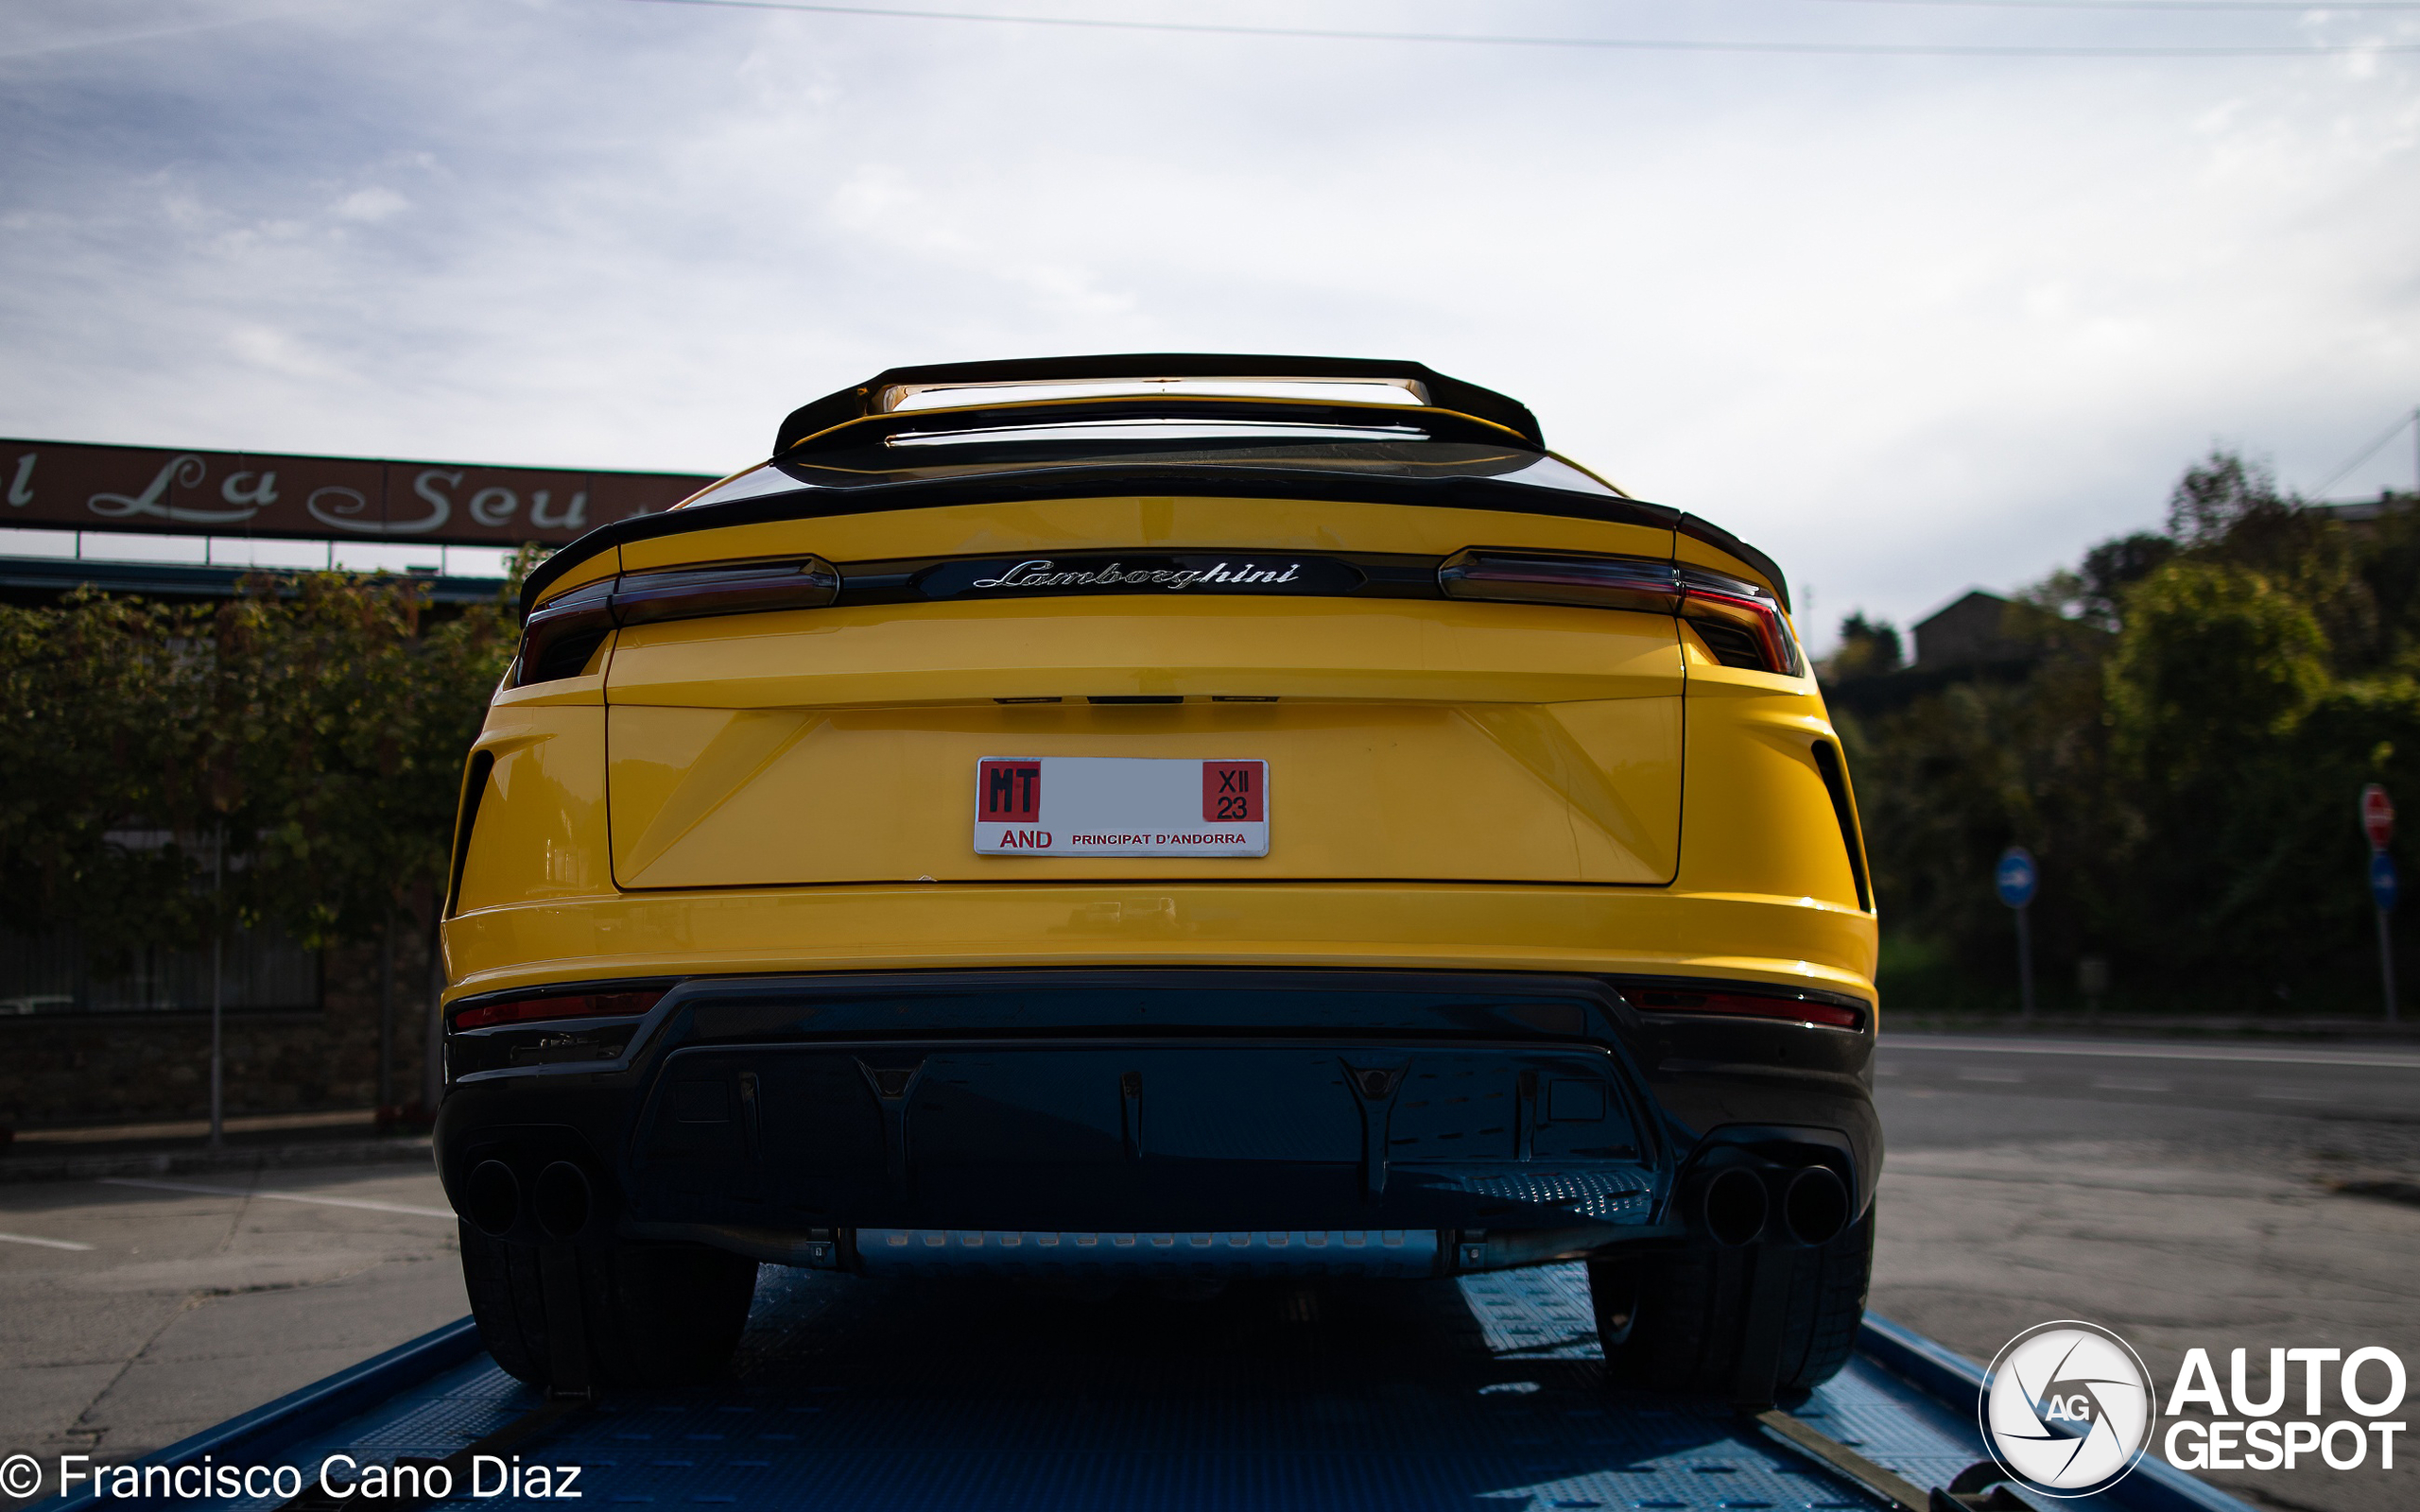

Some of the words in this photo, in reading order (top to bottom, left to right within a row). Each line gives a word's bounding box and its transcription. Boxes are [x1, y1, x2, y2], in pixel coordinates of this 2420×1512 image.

[87, 454, 279, 523] La
[306, 472, 587, 532] Seu
[973, 559, 1300, 589] Lamborghini
[990, 767, 1039, 813] MT
[1219, 770, 1249, 793] XII
[1217, 797, 1248, 819] 23
[999, 830, 1053, 849] AND
[1072, 833, 1151, 845] PRINCIPAT
[1156, 833, 1247, 845] D'ANDORRA
